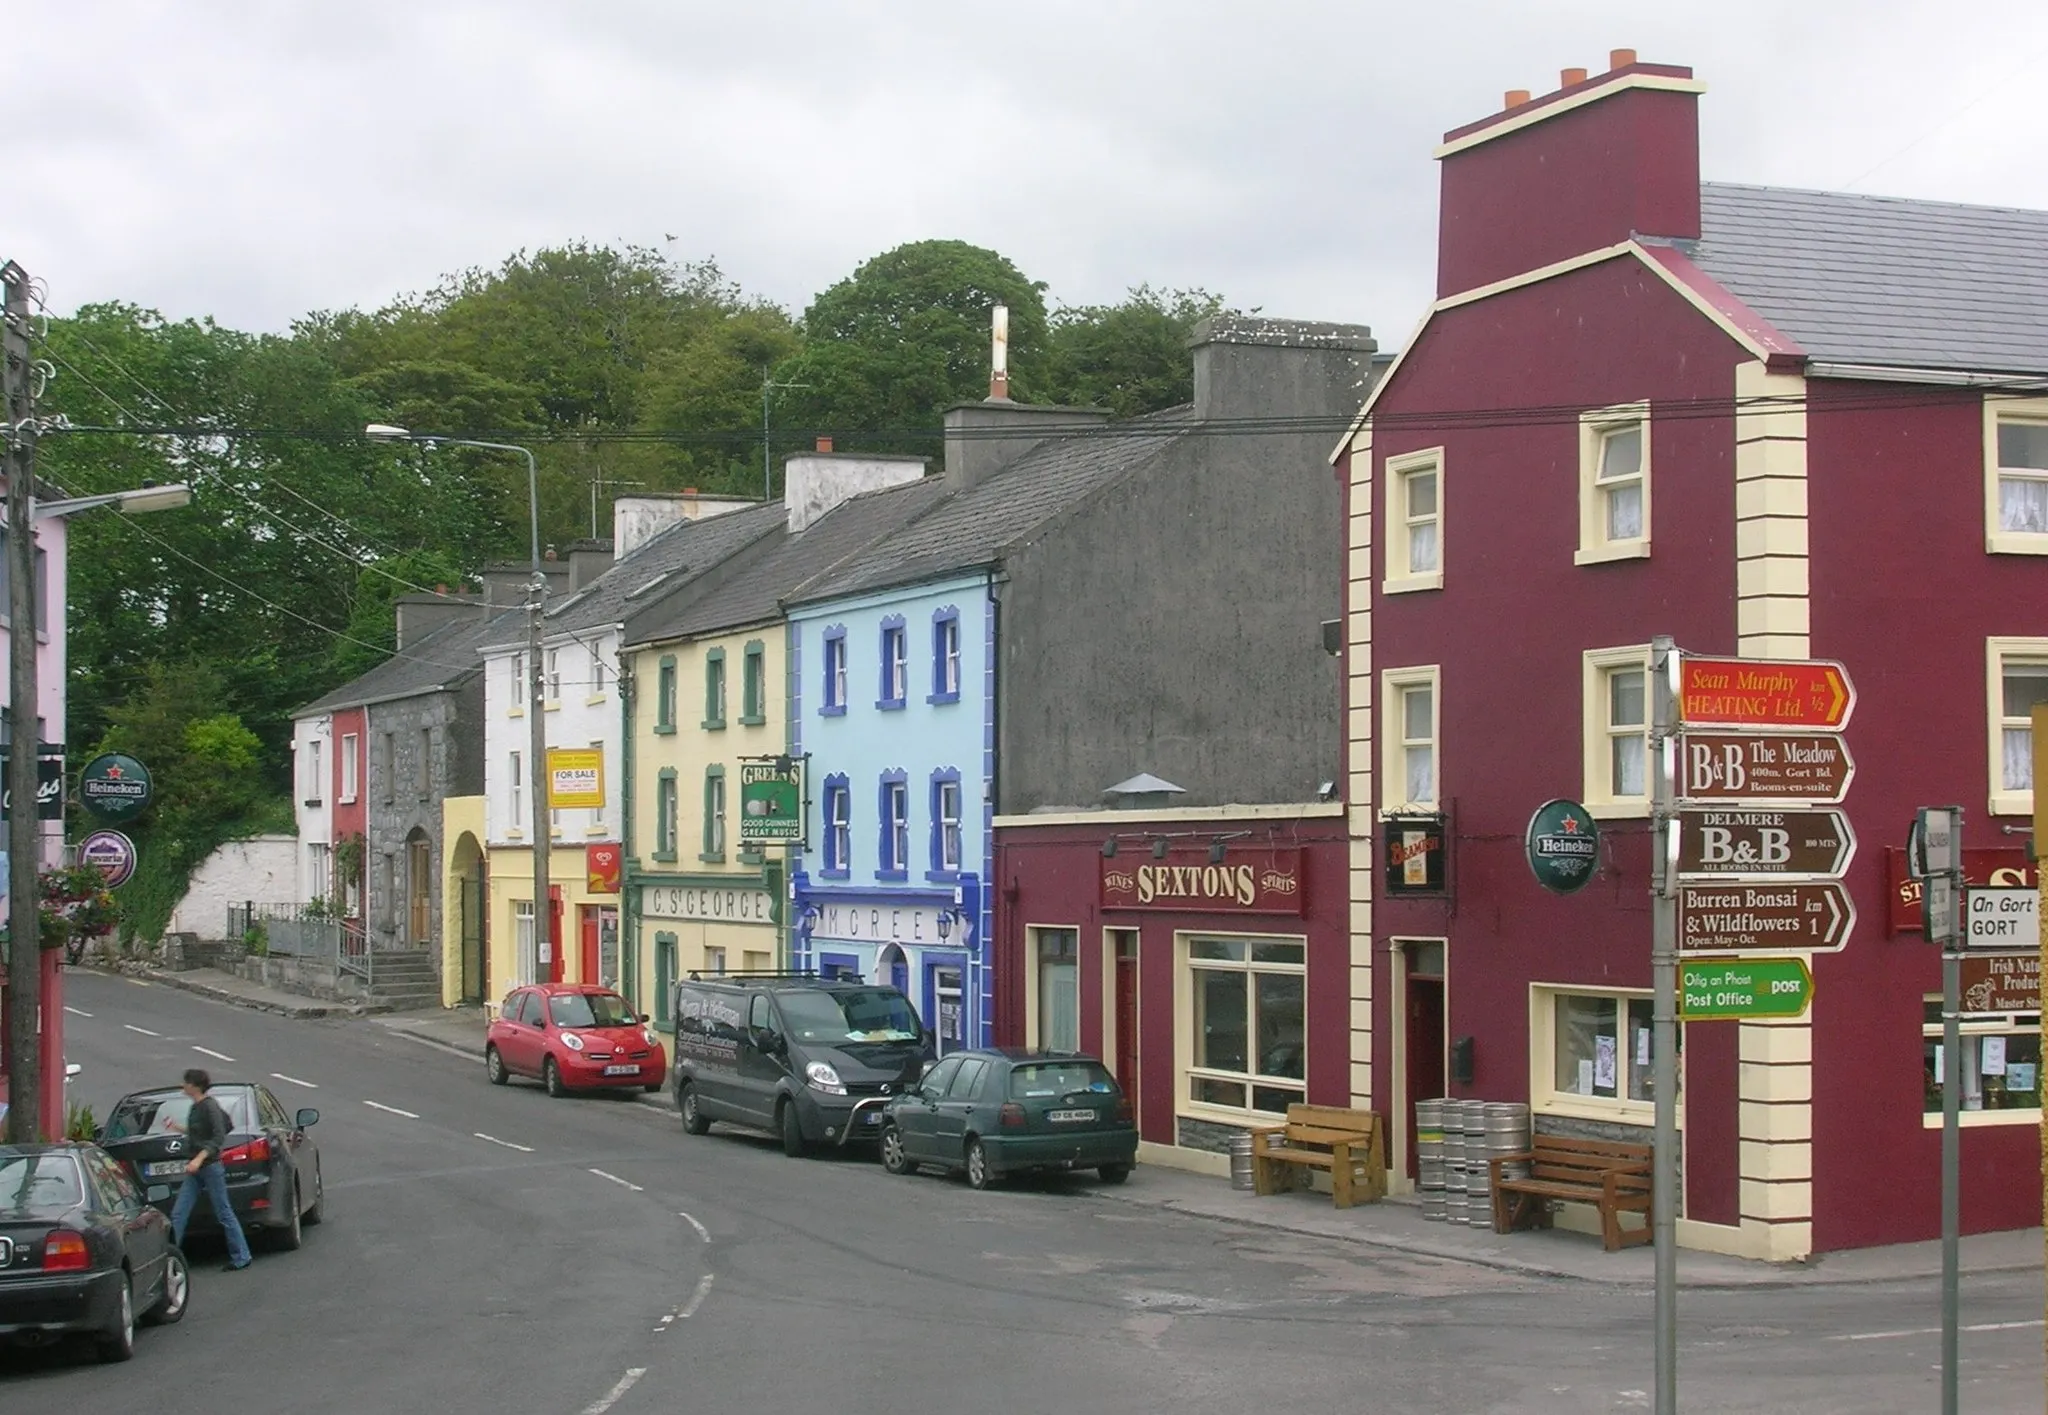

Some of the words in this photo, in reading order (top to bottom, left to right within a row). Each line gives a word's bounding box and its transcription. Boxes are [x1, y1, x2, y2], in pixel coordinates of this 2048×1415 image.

[1691, 669, 1729, 689] Sean
[1736, 671, 1798, 697] Murphy
[1687, 695, 1768, 716] HEATING
[1775, 699, 1804, 717] Ltd.
[1750, 741, 1776, 763] The
[1783, 741, 1837, 764] Meadow
[556, 770, 573, 779] FOR
[575, 769, 596, 778] SALE
[1691, 744, 1746, 790] B&B
[1786, 767, 1810, 778] Gort
[89, 783, 142, 794] Heineken
[742, 819, 764, 827] GOOD
[765, 819, 799, 827] GUINNESS
[1703, 813, 1784, 826] DELMERE
[742, 828, 769, 837] GREAT
[771, 828, 799, 836] MUSIC
[1543, 839, 1594, 853] Heineken
[1700, 827, 1791, 864] B&B
[1720, 864, 1749, 872] ROOMS
[1104, 874, 1134, 889] WINES
[1137, 864, 1256, 906] SEXTONS
[1261, 874, 1297, 893] SPIRITS
[686, 889, 764, 919] GEORGE
[1686, 890, 1742, 909] Burren
[1745, 889, 1798, 908] Bonsai
[1805, 898, 1822, 913] km
[2000, 896, 2033, 912] Gort
[1686, 916, 1700, 933] &
[1702, 914, 1800, 932] Wildflowers
[1809, 918, 1819, 935] 1
[1972, 920, 2018, 935] GORT
[1990, 958, 2014, 974] Irish
[1685, 993, 1712, 1007] Post
[1716, 992, 1753, 1006] Office
[1995, 998, 2025, 1009] Master
